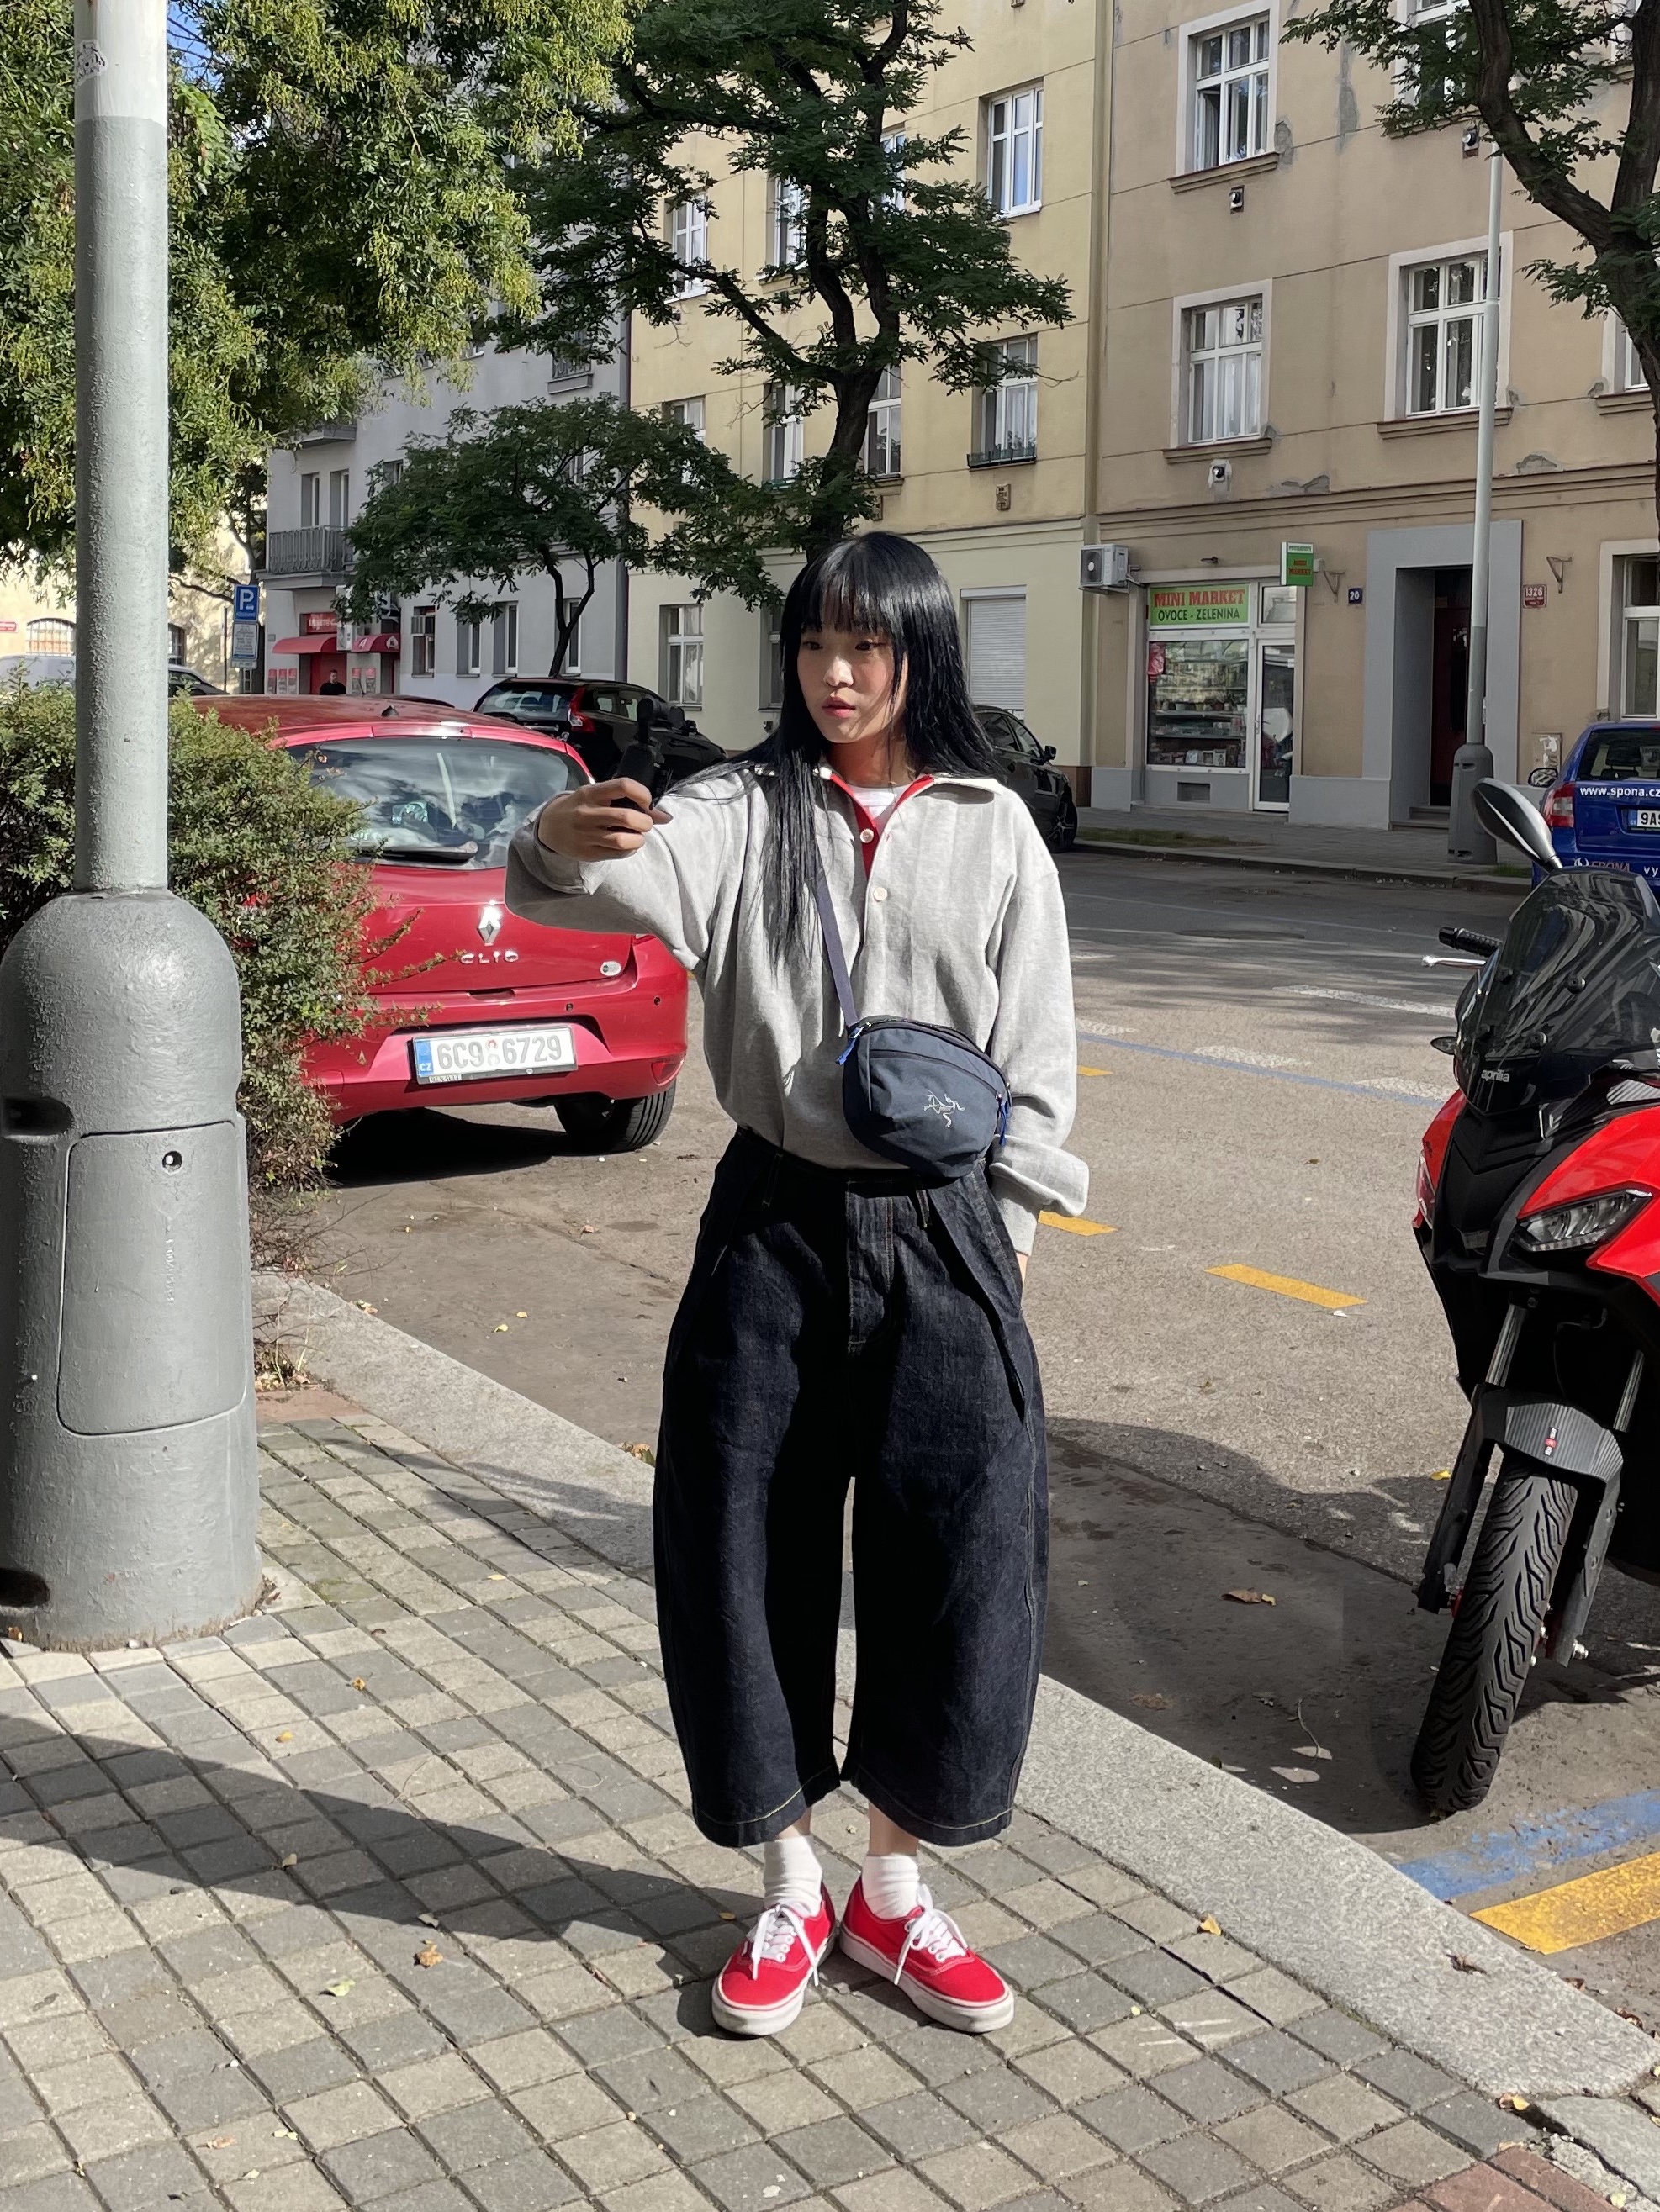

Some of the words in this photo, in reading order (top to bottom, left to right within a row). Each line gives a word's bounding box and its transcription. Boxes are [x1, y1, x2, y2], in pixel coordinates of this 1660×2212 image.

[239, 589, 255, 610] P
[1154, 592, 1186, 608] MINI
[1189, 589, 1245, 605] MARKET
[1349, 590, 1360, 600] 20
[1158, 609, 1188, 621] OVOCE
[1196, 608, 1240, 620] ZELENINA
[1579, 787, 1660, 798] www.spona.cz
[461, 950, 519, 964] CLIO
[502, 1035, 562, 1064] 6729
[420, 1063, 432, 1072] CZ
